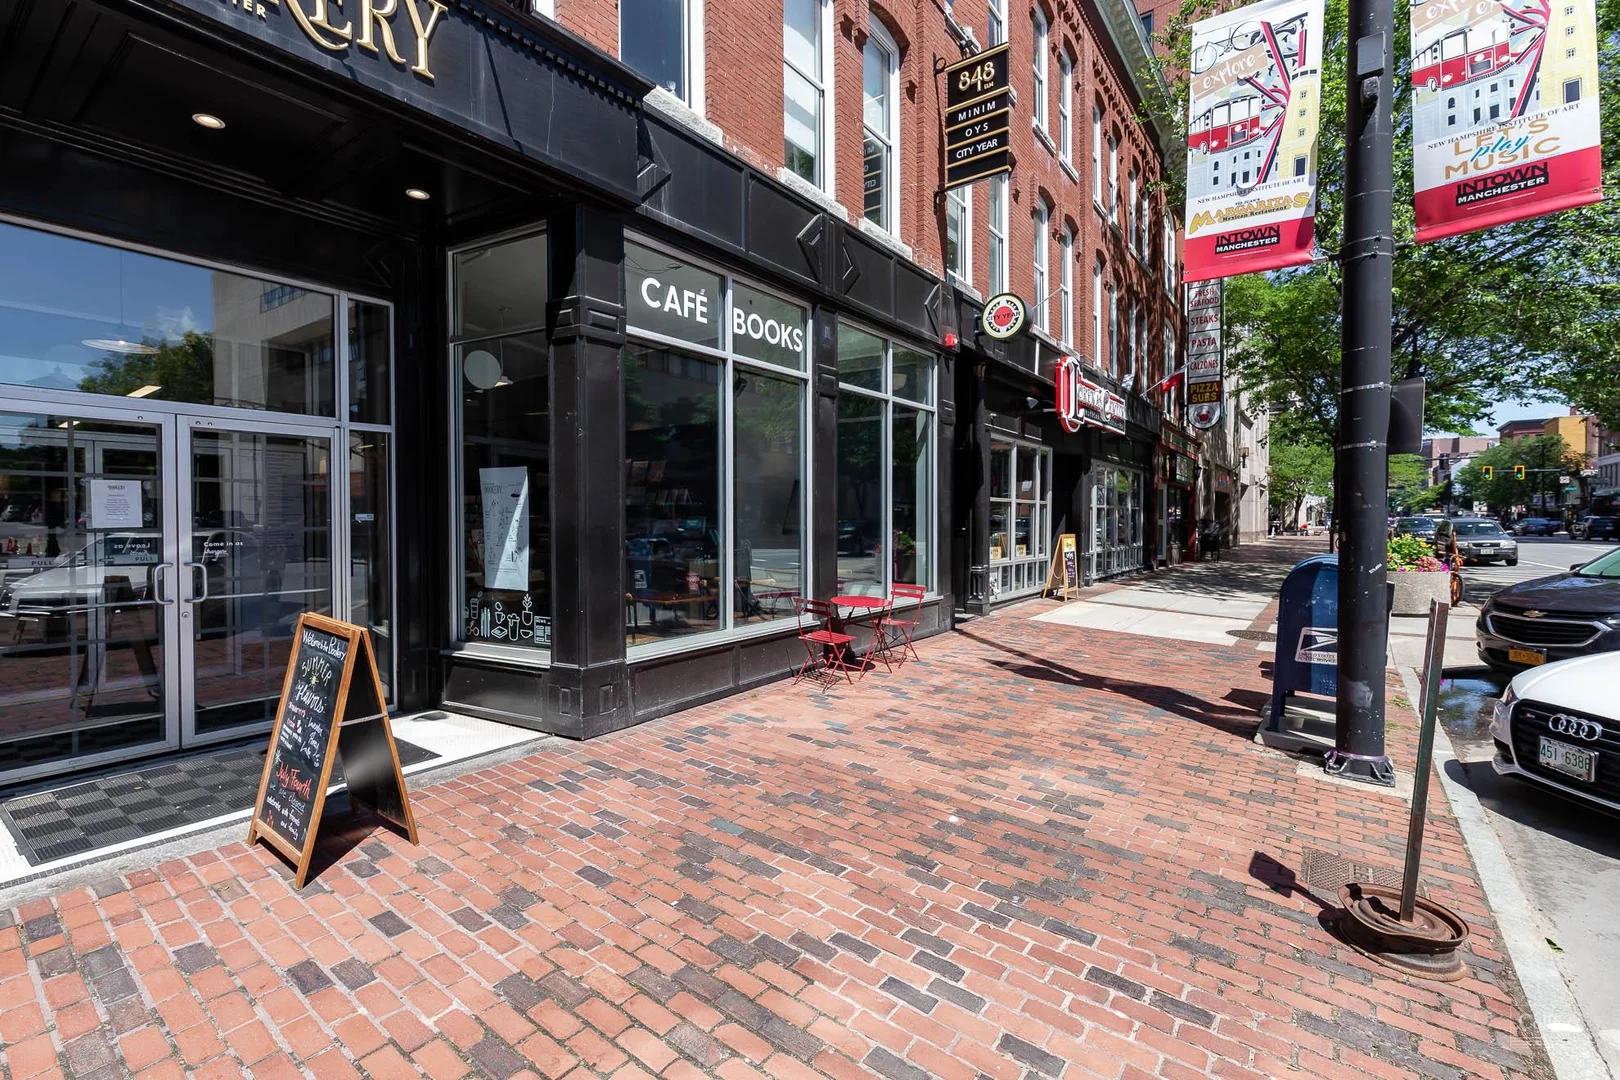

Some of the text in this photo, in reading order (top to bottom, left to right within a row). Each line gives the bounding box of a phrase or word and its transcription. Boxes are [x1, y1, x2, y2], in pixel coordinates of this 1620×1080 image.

[958, 61, 995, 92] 848
[1203, 54, 1255, 89] explore
[958, 101, 996, 121] MINIM
[965, 122, 989, 137] OYS
[1427, 102, 1581, 150] NEW HAMPSHIRE INSTITUTE OF ART
[1454, 118, 1549, 156] LET'S
[956, 138, 998, 159] CITY YEAR
[1444, 137, 1560, 180] MUSIC
[1470, 135, 1534, 163] play
[1292, 176, 1305, 185] ART
[1457, 161, 1548, 197] INTOWN
[1457, 176, 1546, 204] MANCHESTER
[1189, 191, 1310, 235] MARGARITAS
[1222, 206, 1287, 222] Mexican Restaurant
[1216, 225, 1280, 246] INTOWN
[1216, 237, 1278, 253] MANCHESTER
[640, 277, 708, 324] CAFÉ
[1195, 287, 1215, 297] FRESH
[1190, 297, 1219, 308] SEAFOOD
[1002, 311, 1020, 319] YEAR
[1191, 314, 1218, 326] STEAKS
[733, 307, 803, 353] BOOKS
[1191, 337, 1217, 348] PASTA
[1190, 359, 1219, 370] CALZONES
[1190, 382, 1219, 393] PIZZA
[1191, 393, 1217, 403] SUBS
[301, 656, 332, 687] SUMMER
[1540, 744, 1557, 760] 451
[276, 761, 312, 800] July Fourth
[288, 792, 306, 811] closed
